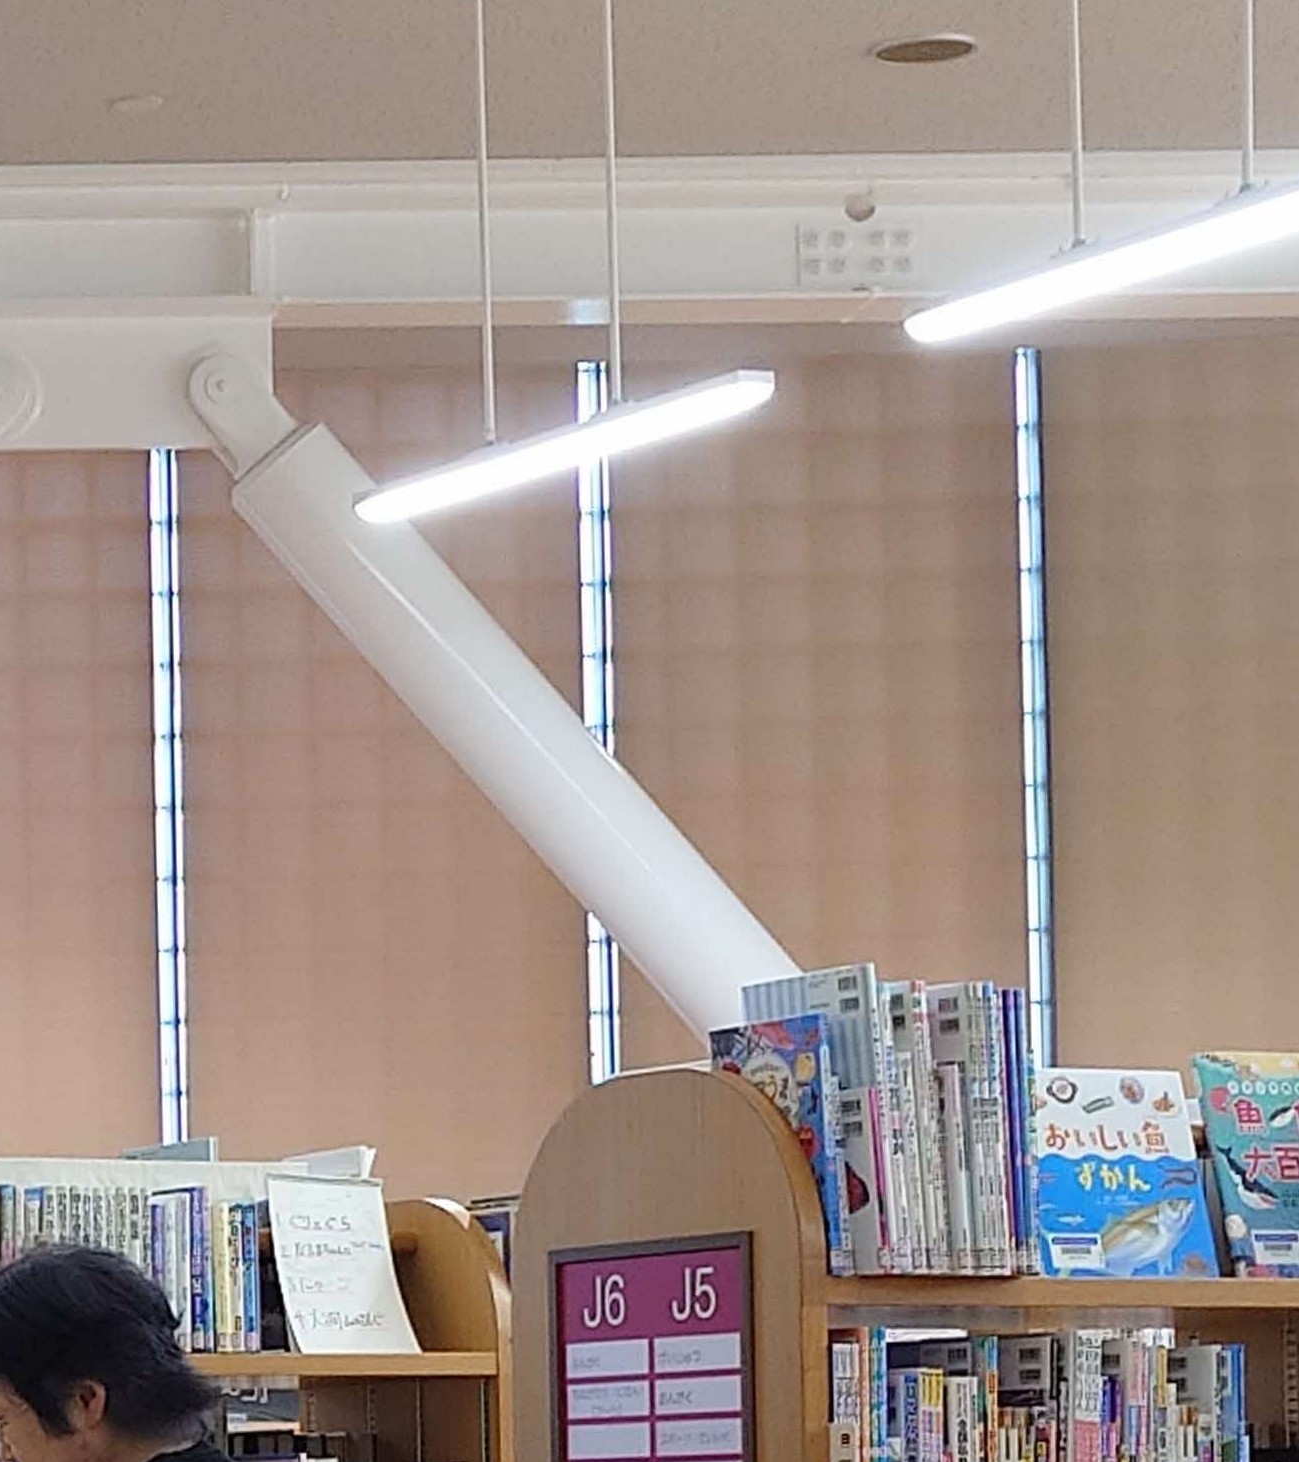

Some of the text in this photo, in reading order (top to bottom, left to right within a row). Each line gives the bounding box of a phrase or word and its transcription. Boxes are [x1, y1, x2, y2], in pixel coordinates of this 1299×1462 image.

[1045, 1121, 1170, 1154] おいしい魚
[1074, 1161, 1152, 1192] ずかん
[583, 1266, 717, 1328] J6 J5
